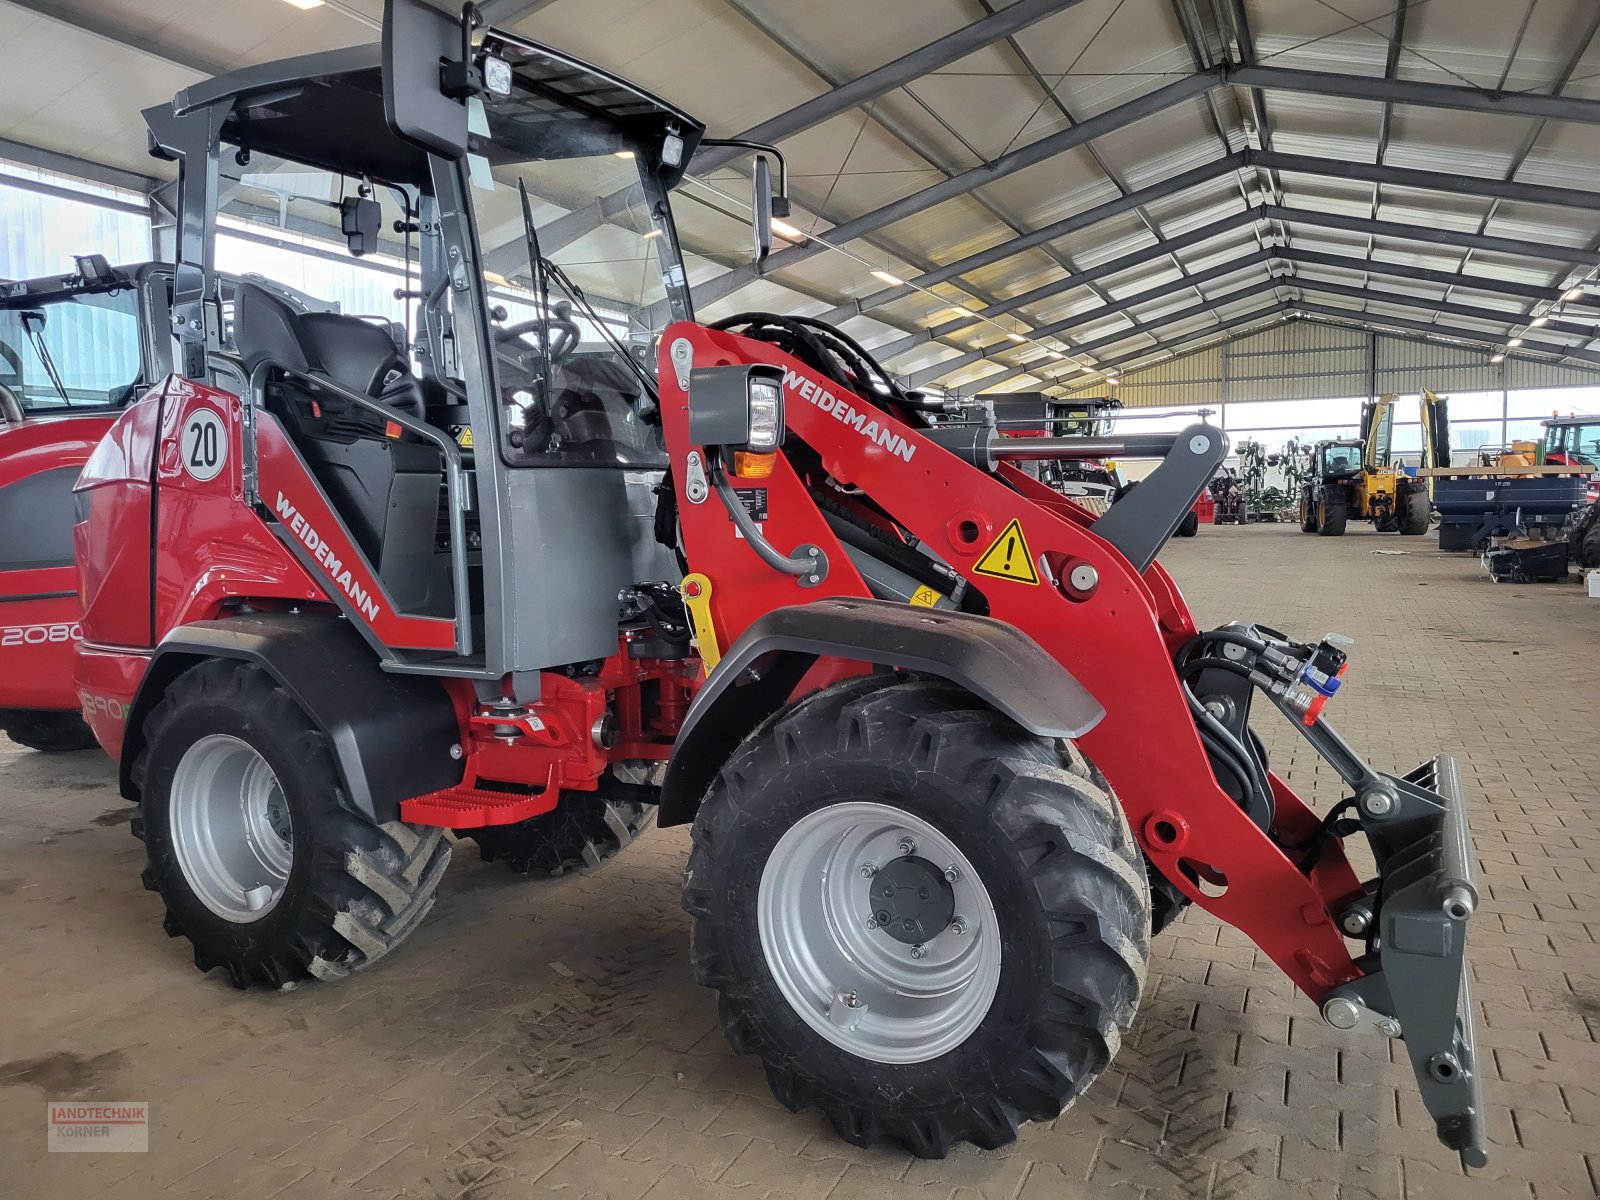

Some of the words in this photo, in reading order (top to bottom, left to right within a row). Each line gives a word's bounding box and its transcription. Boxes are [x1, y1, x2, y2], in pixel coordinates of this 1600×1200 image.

[190, 422, 217, 467] 20
[782, 364, 917, 463] WEIDEMANN
[276, 490, 380, 622] WEIDEMANN
